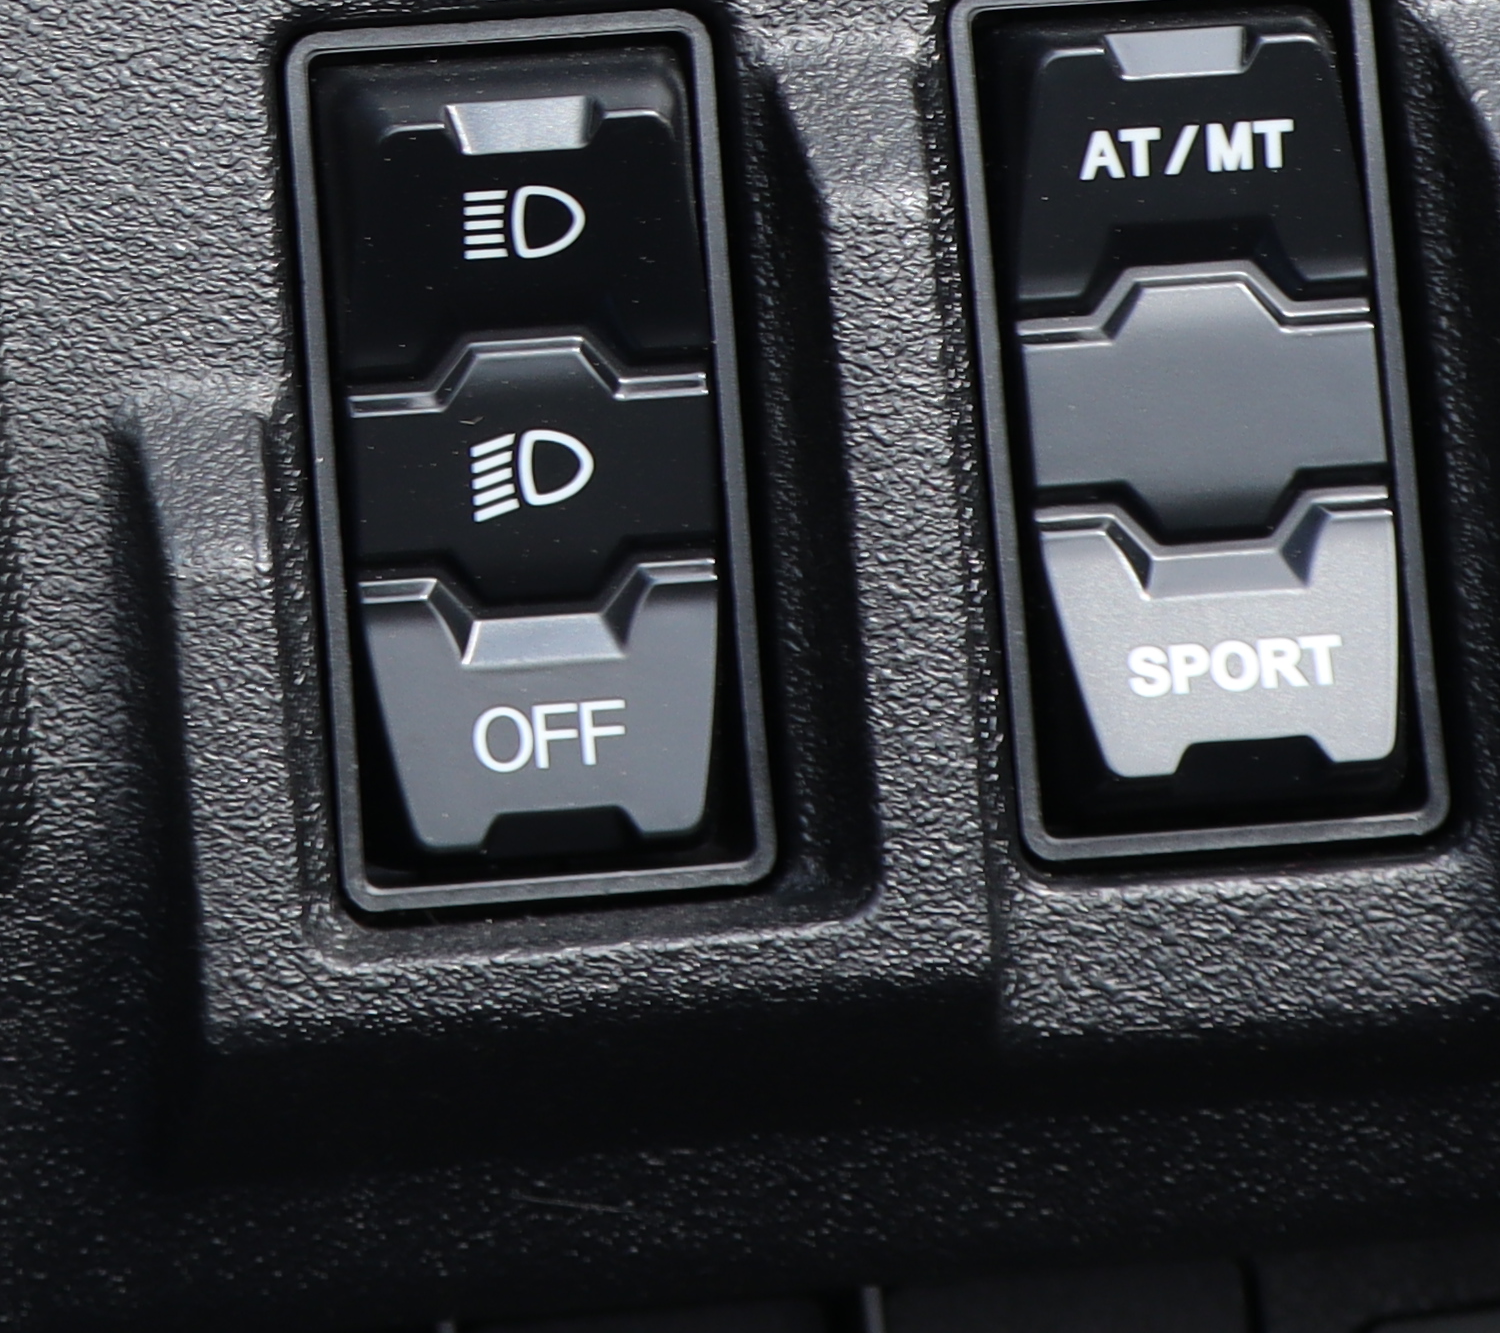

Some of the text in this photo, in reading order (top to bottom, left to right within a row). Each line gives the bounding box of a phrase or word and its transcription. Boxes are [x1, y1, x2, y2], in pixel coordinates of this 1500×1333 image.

[1080, 117, 1295, 181] AT/MT
[1127, 633, 1344, 699] SPORT
[471, 697, 628, 775] OFF
